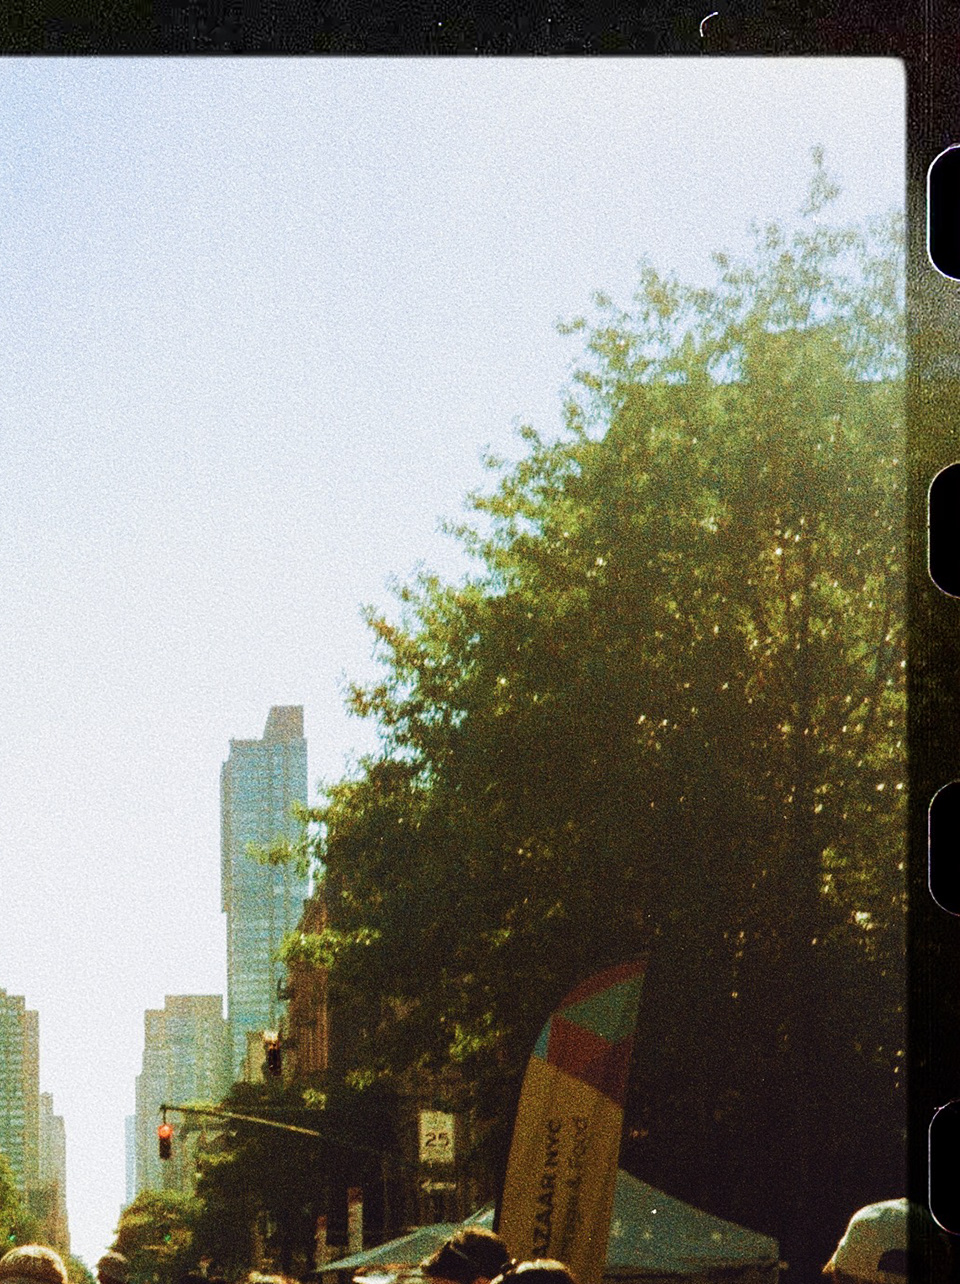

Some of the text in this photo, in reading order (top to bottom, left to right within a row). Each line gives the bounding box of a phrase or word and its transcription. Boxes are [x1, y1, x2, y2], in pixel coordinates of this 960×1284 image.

[425, 1132, 450, 1148] 25
[532, 1119, 562, 1257] AZAAR NYC
